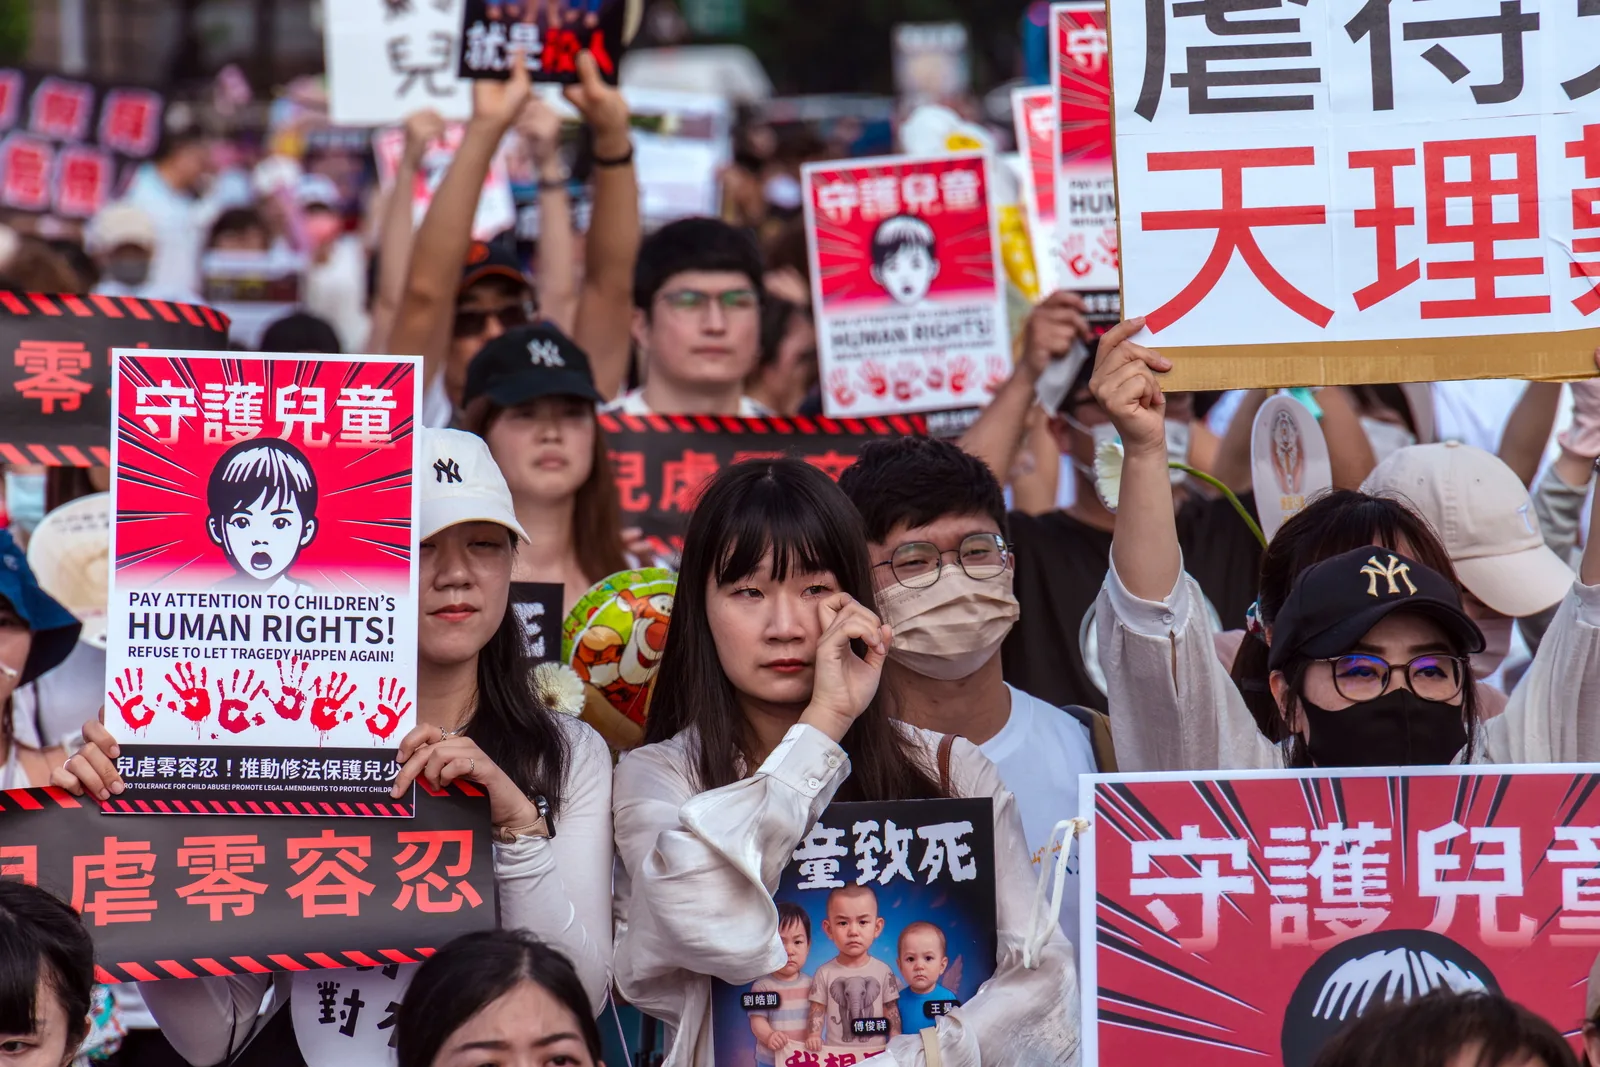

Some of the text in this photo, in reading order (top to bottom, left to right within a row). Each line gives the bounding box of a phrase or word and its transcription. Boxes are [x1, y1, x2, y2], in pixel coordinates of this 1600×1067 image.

[1134, 0, 1600, 121] 虐待
[13, 339, 111, 415] 零
[135, 379, 398, 451] 守護兒童
[433, 458, 463, 483] NY
[1360, 554, 1418, 597] NY
[128, 592, 161, 607] PAY
[164, 593, 262, 609] ATTENTION
[266, 594, 290, 609] TO
[128, 612, 395, 645] HUMAN RIGHTS!
[128, 646, 394, 663] REFUSE TO LET TRAGEDY HAPPEN AGAIN!
[134, 782, 172, 791] TOLERANCE
[172, 783, 187, 791] FOR
[188, 783, 207, 791] CHILD
[207, 783, 231, 792] ABUSE!
[231, 784, 263, 792] PROMOTE
[263, 784, 284, 792] LEGAL
[284, 785, 329, 793] AMENDMENTS
[329, 785, 339, 793] TO
[339, 785, 368, 793] PROTECT
[792, 818, 977, 891] 童致死
